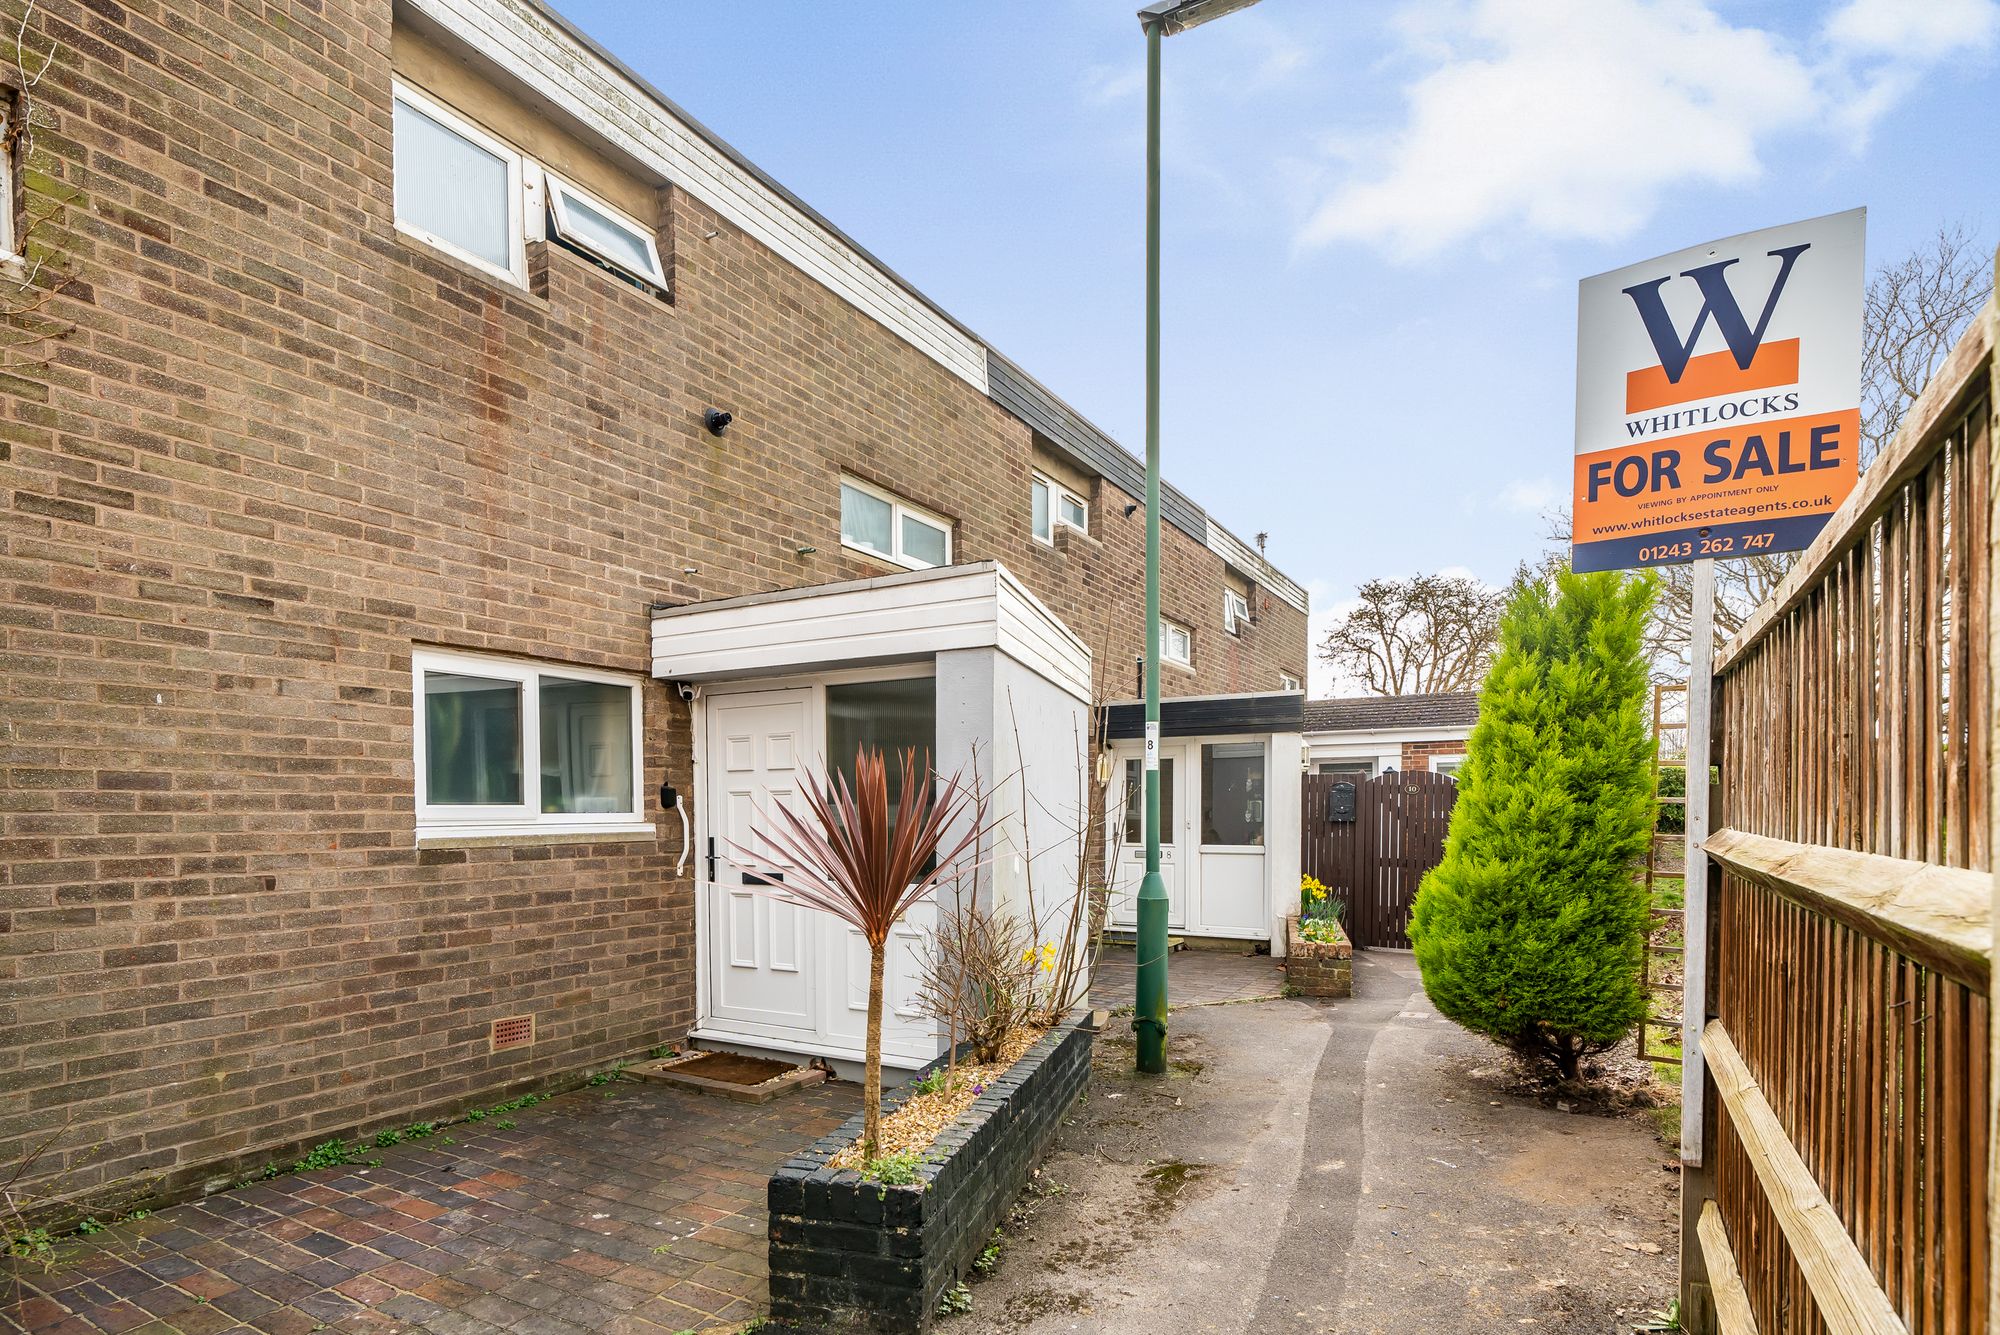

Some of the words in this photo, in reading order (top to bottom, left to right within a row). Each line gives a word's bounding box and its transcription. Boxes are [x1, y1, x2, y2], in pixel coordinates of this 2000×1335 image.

[1622, 243, 1811, 384] W
[1626, 392, 1799, 438] WHITLOCKS
[1588, 449, 1680, 503] FOR
[1704, 424, 1840, 484] SALE
[1637, 498, 1673, 509] VIEWING
[1690, 487, 1753, 502] APPOINTMENT
[1756, 485, 1779, 494] ONLY
[1592, 495, 1832, 535] www.whitlocksestateagents.co.uk
[1639, 541, 1692, 561] 01243
[1700, 538, 1733, 553] 262
[1742, 532, 1775, 549] 747
[1147, 740, 1154, 750] 8
[1166, 850, 1172, 860] 8
